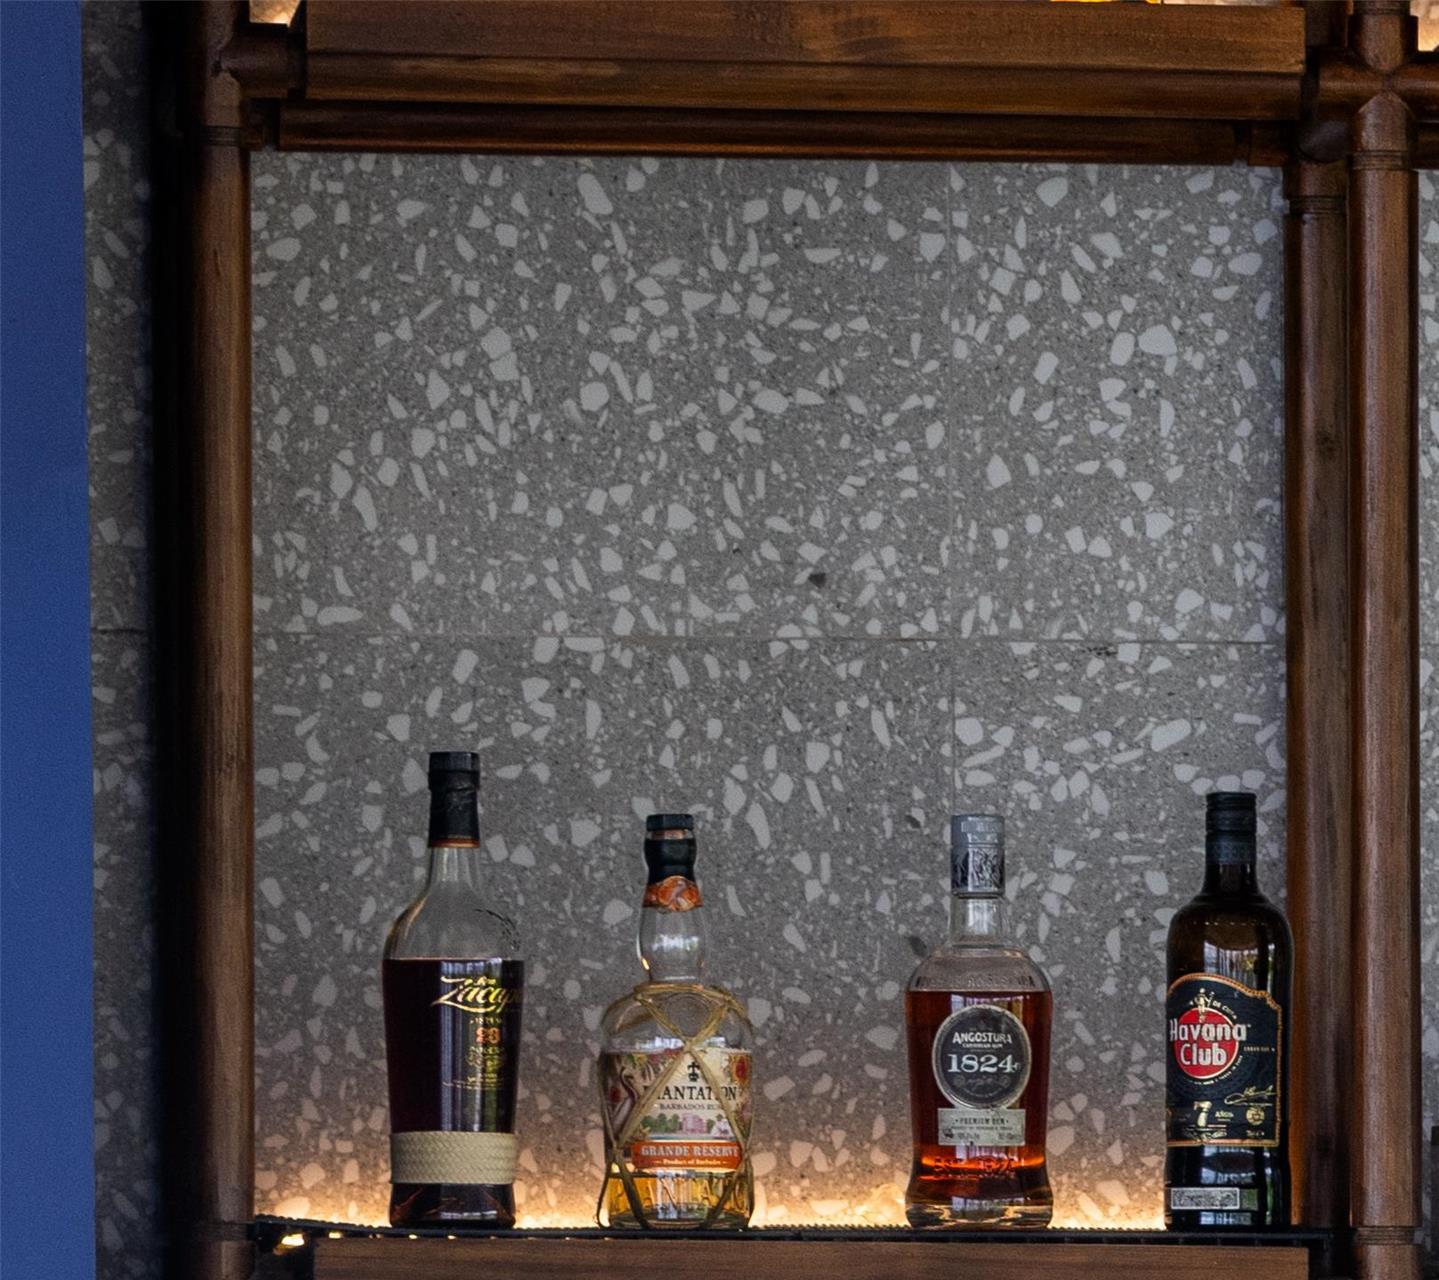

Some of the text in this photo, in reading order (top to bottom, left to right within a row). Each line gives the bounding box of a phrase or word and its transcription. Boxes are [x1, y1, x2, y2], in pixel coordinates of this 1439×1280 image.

[952, 1032, 1013, 1045] ANGOSTURA
[1169, 1018, 1247, 1044] Havana
[948, 1054, 1016, 1073] 1824
[1179, 1042, 1229, 1066] Club
